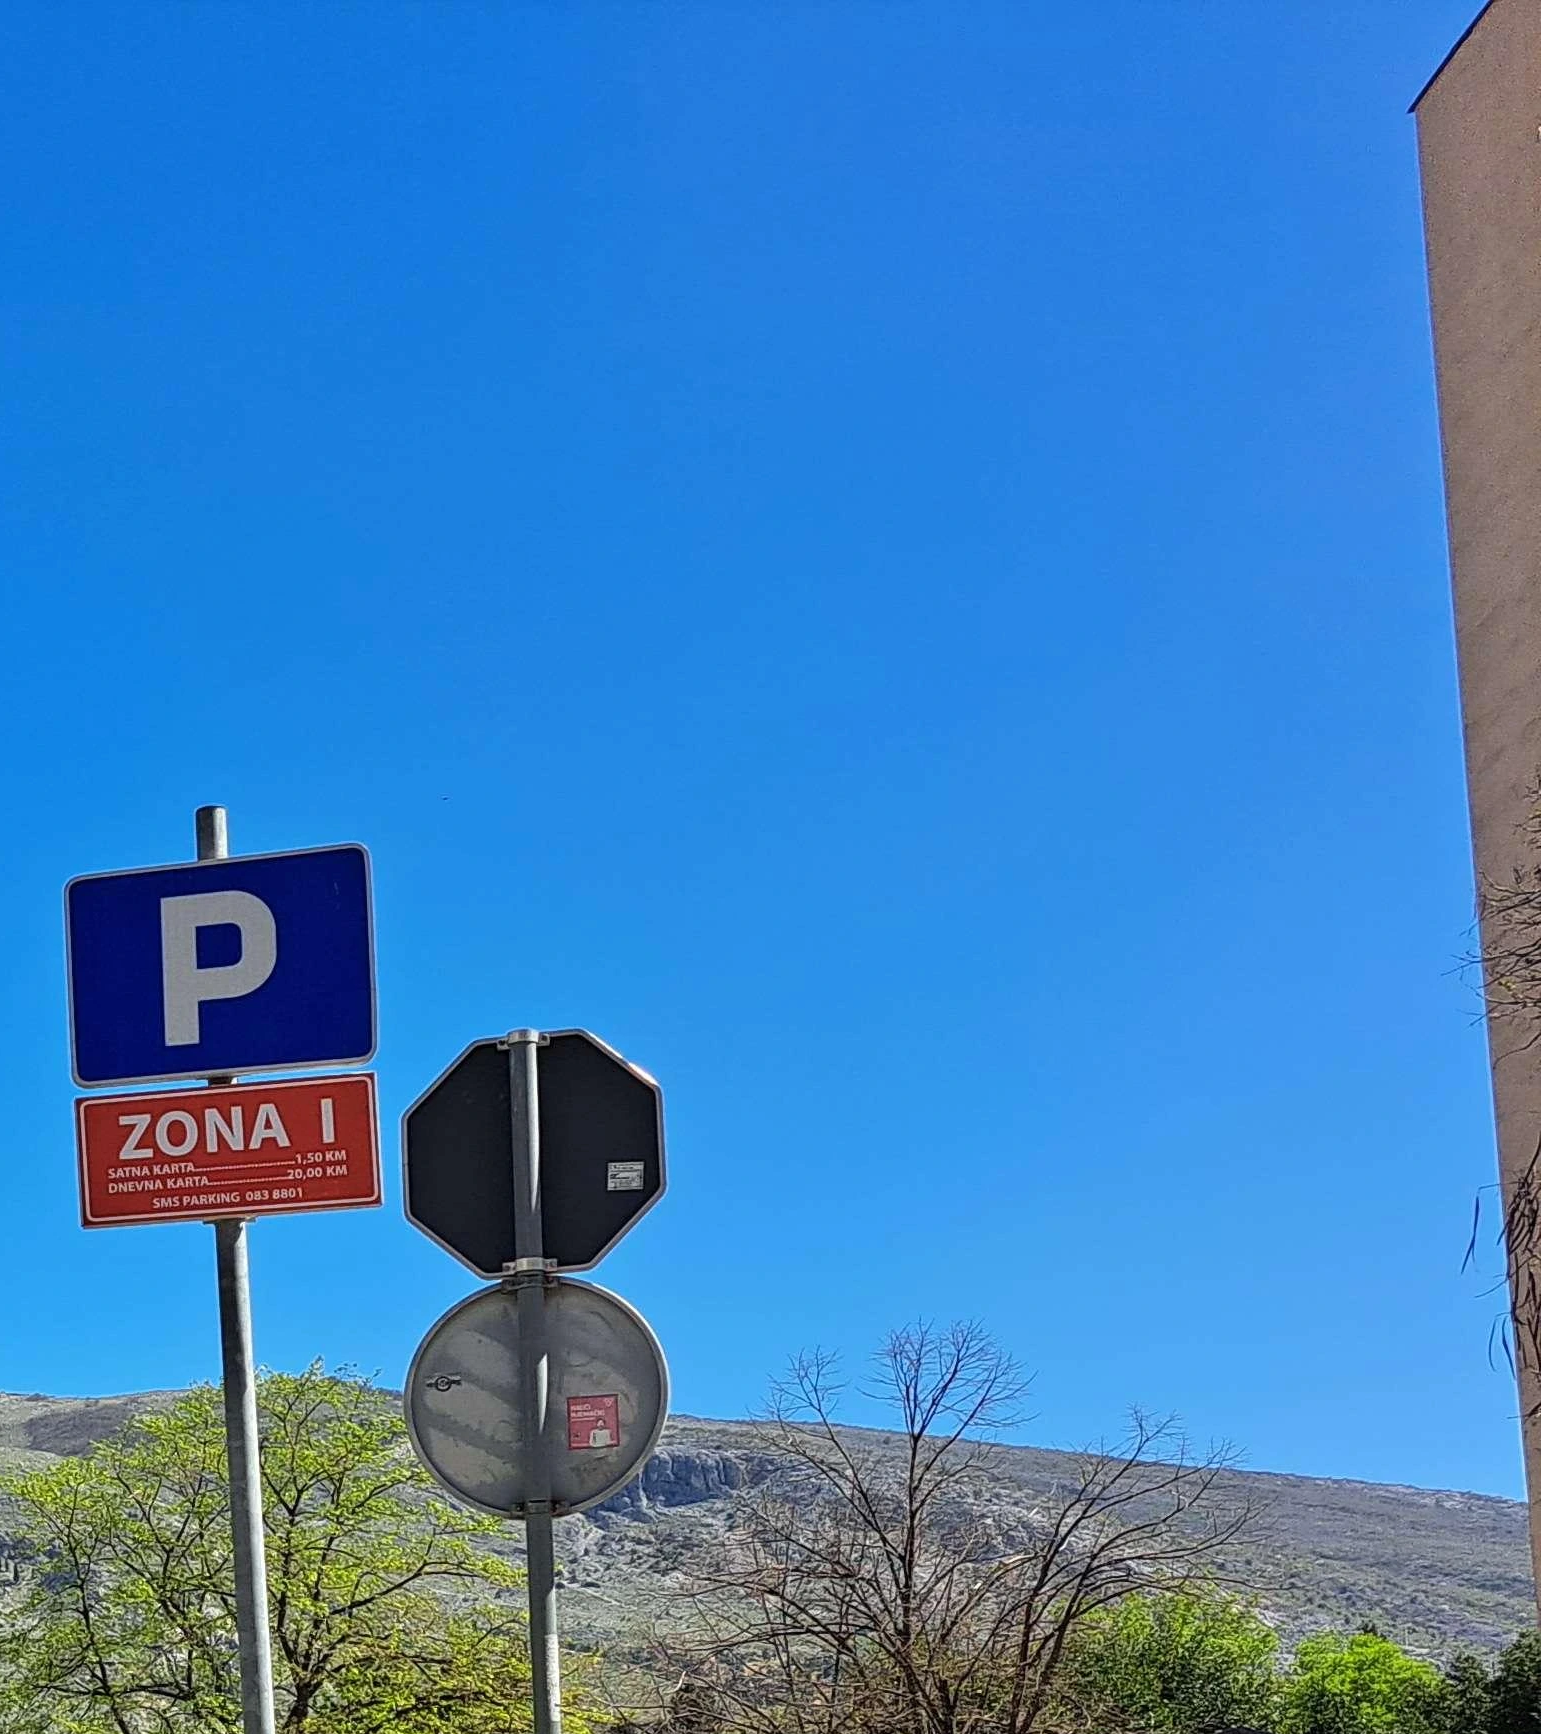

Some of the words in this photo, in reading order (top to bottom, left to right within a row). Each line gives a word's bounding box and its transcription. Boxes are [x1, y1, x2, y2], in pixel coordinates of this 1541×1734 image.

[160, 889, 277, 1047] P
[118, 1103, 291, 1160] ZONA
[108, 1165, 150, 1179] SATNA
[153, 1162, 195, 1176] KARTA
[295, 1152, 322, 1165] 1,50
[326, 1150, 347, 1162] KM
[108, 1180, 163, 1194] DNEVNA
[166, 1176, 209, 1189] KARTA
[287, 1167, 322, 1181] 20,00
[326, 1165, 347, 1177] KM
[152, 1197, 180, 1210] SMS
[183, 1192, 240, 1207] PARKING
[245, 1190, 269, 1202] 083
[272, 1187, 303, 1200] 8801
